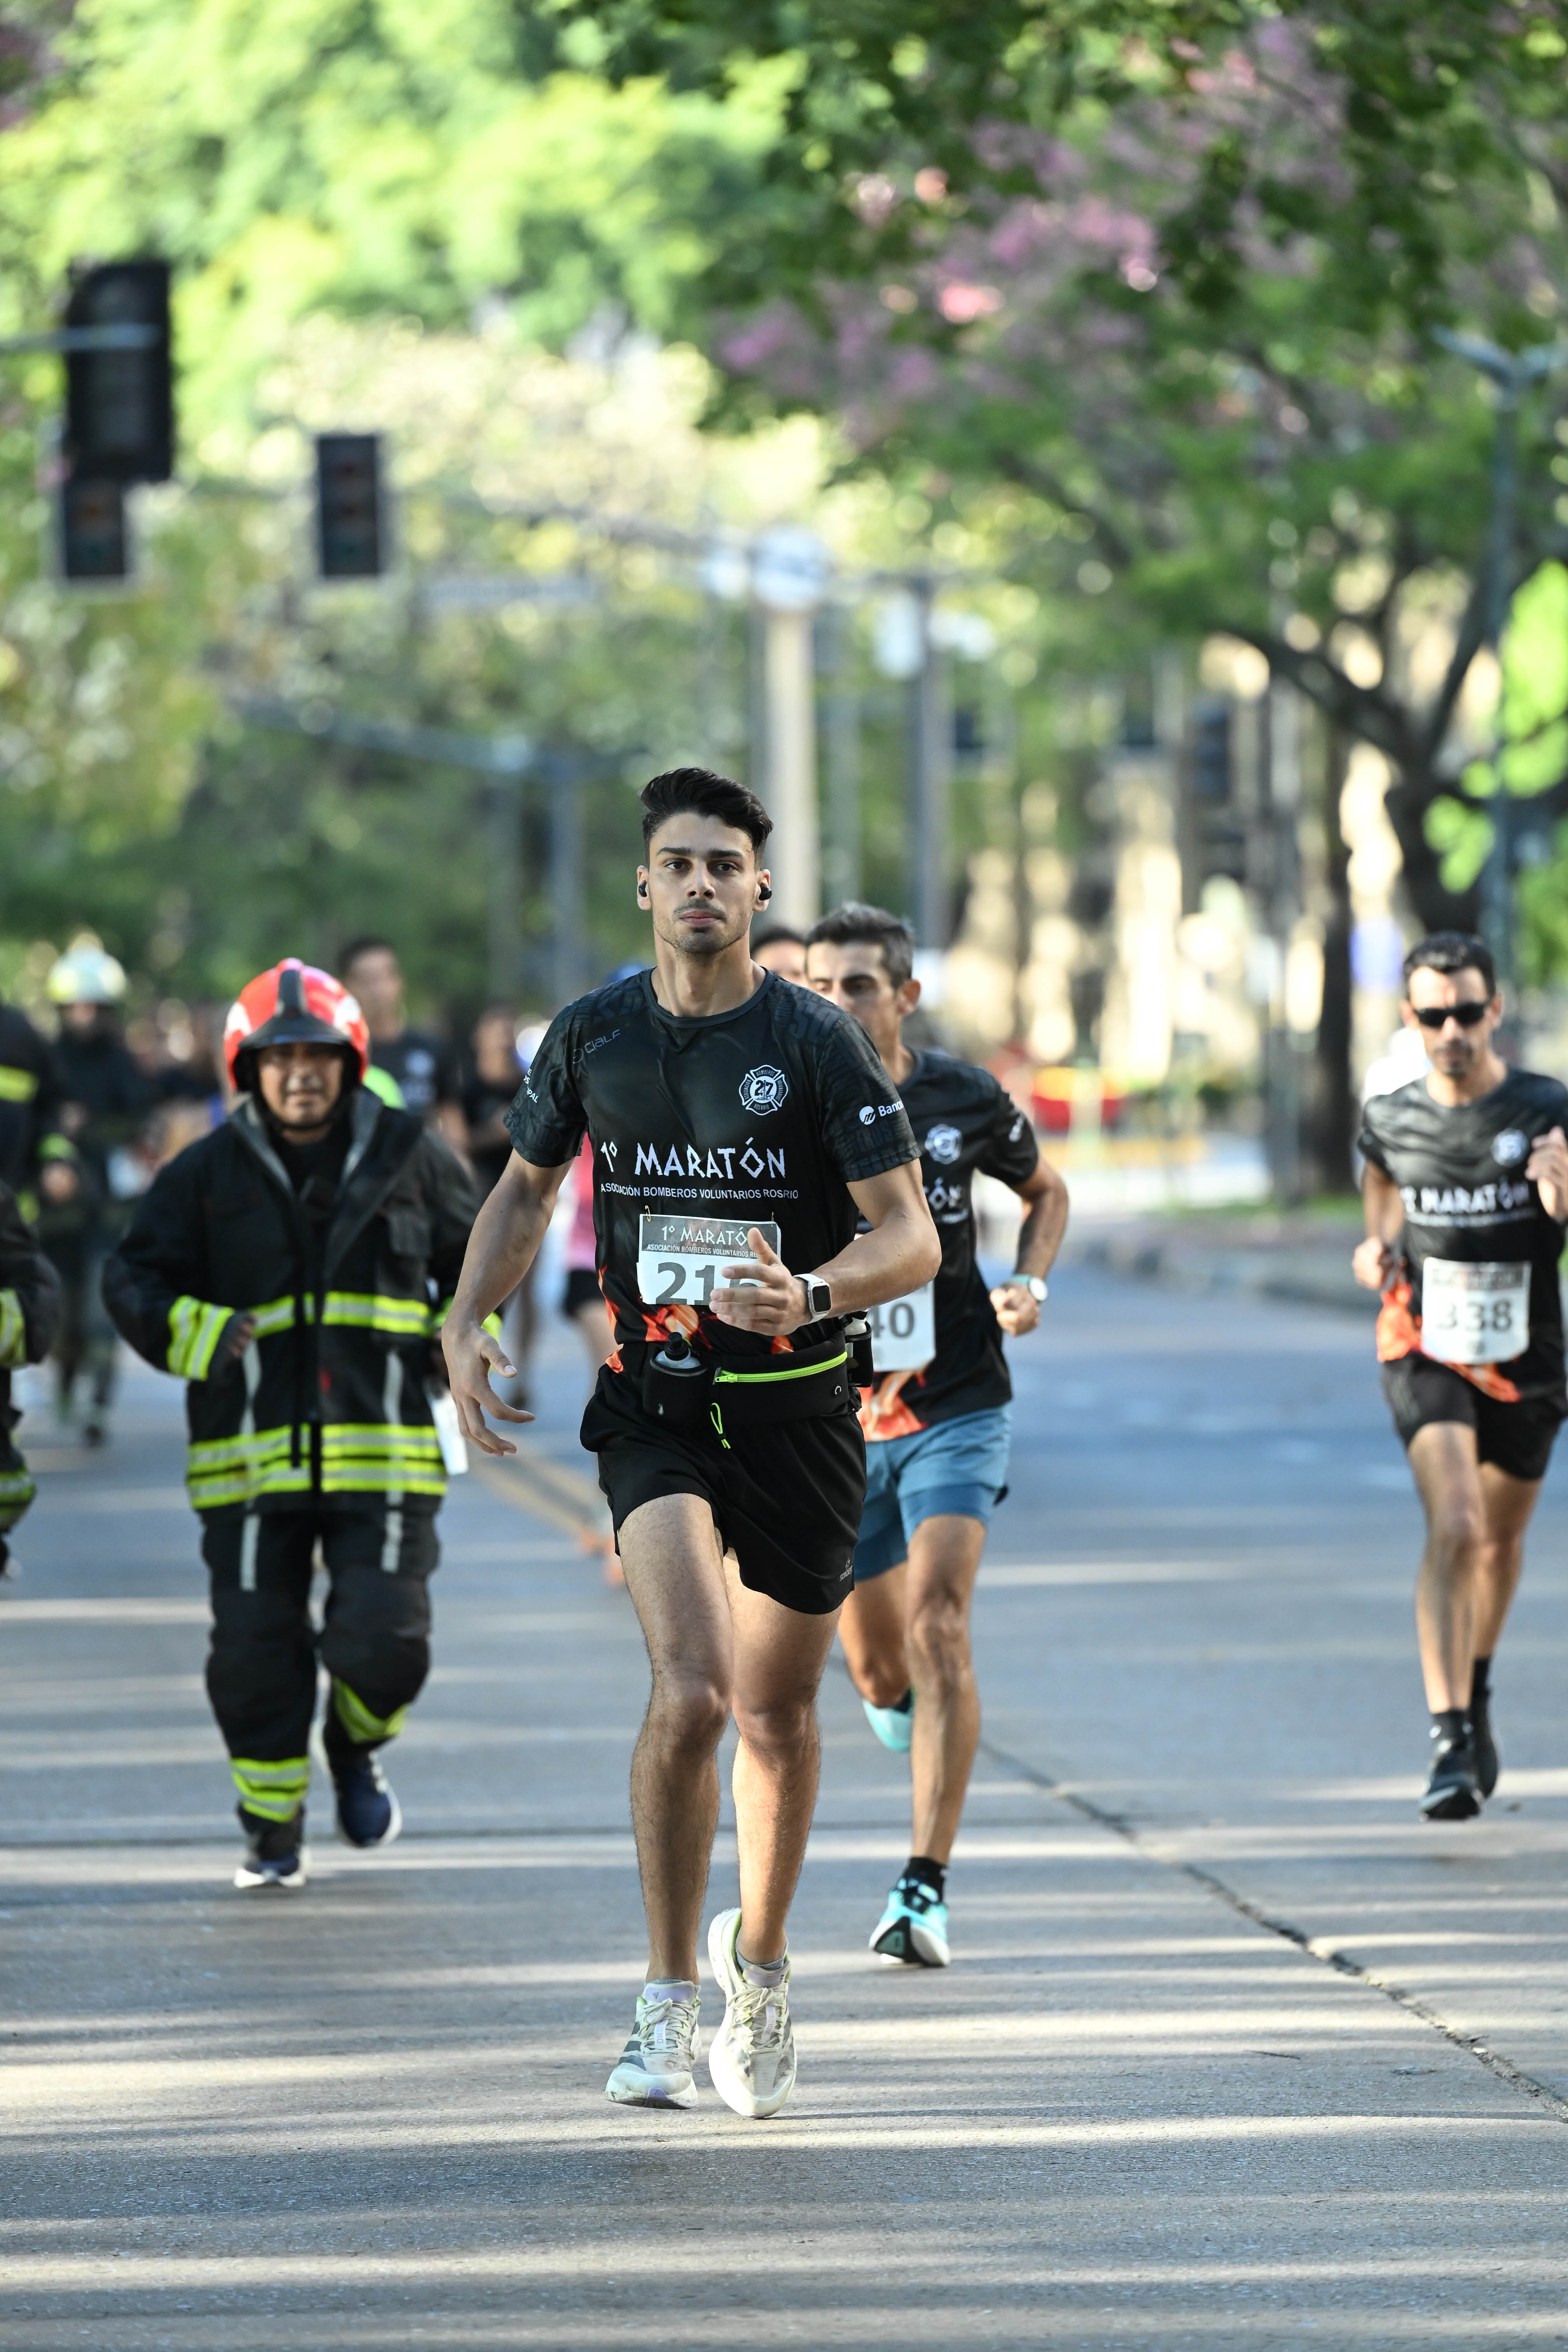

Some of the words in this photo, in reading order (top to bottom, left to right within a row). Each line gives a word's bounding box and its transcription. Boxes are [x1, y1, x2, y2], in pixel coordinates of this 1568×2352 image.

[754, 1080, 774, 1096] 27
[635, 1136, 786, 1179] MARATÓN
[601, 1183, 640, 1197] ASOCIACIÓN
[644, 1186, 697, 1198] BOMBEROS
[699, 1189, 761, 1199] VOLUNTARIOS
[763, 1188, 798, 1199] ROSRIO
[681, 1226, 749, 1247] MARATÓ
[647, 1244, 680, 1252] ASOCIACIÓN
[681, 1246, 712, 1254] BOMBEROS
[712, 1249, 749, 1258] VOLUNTARIOS
[1436, 1299, 1512, 1332] 338
